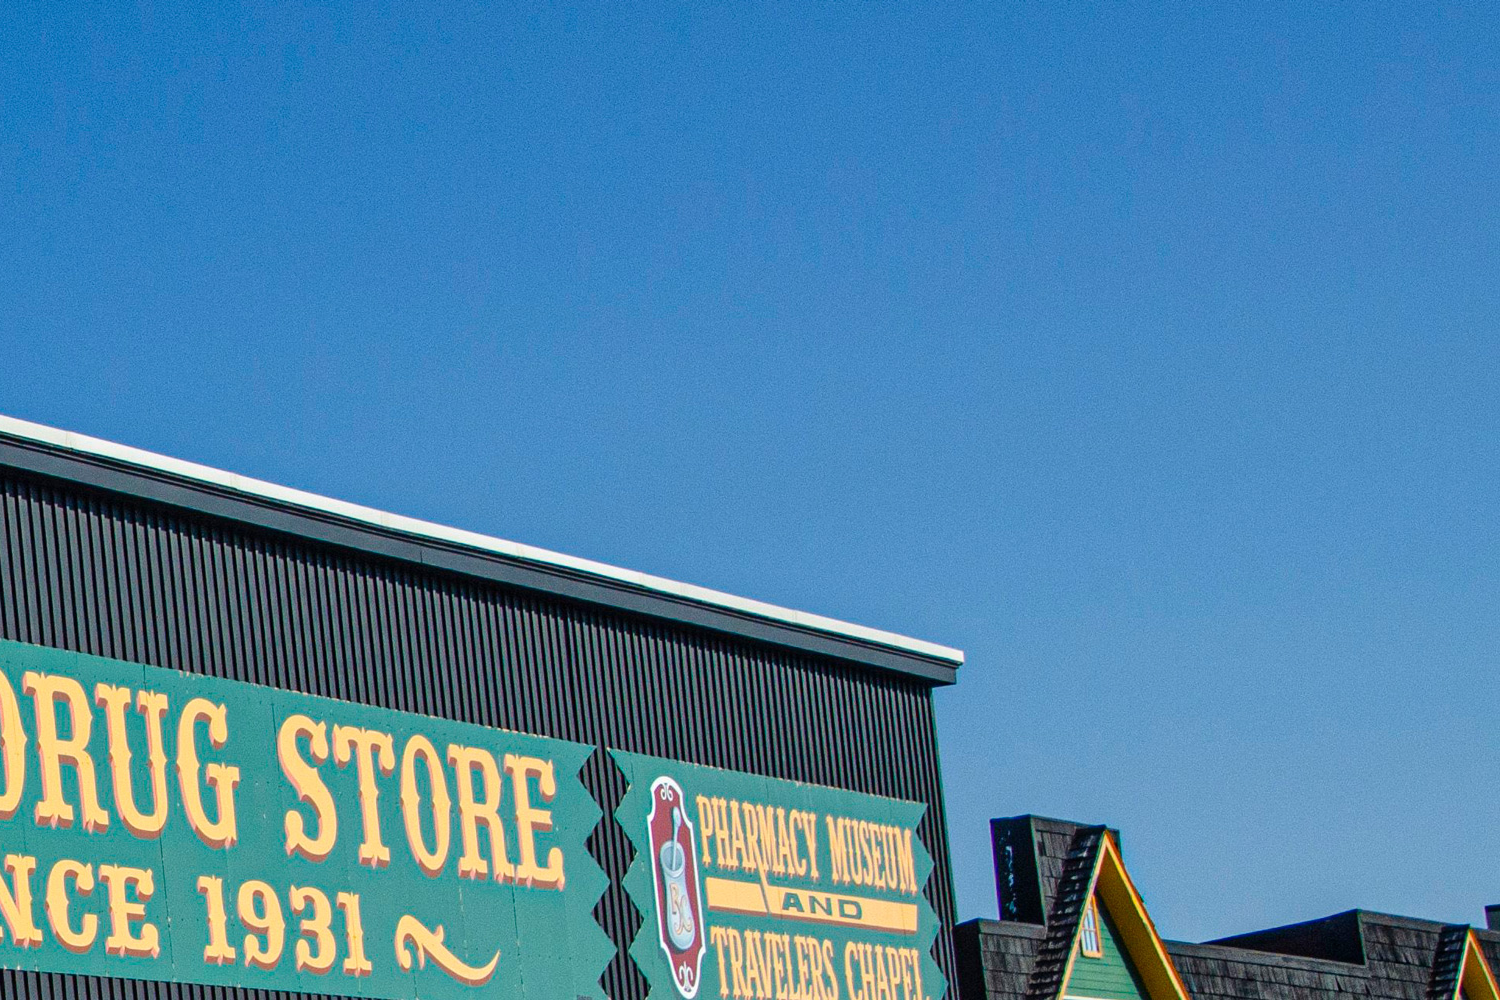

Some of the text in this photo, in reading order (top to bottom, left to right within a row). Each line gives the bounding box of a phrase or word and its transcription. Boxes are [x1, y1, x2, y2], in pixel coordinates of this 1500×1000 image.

[278, 715, 565, 890] STORE
[696, 794, 917, 896] PHARMACY MUSEUM
[199, 875, 372, 976] 1931
[781, 892, 863, 920] AND
